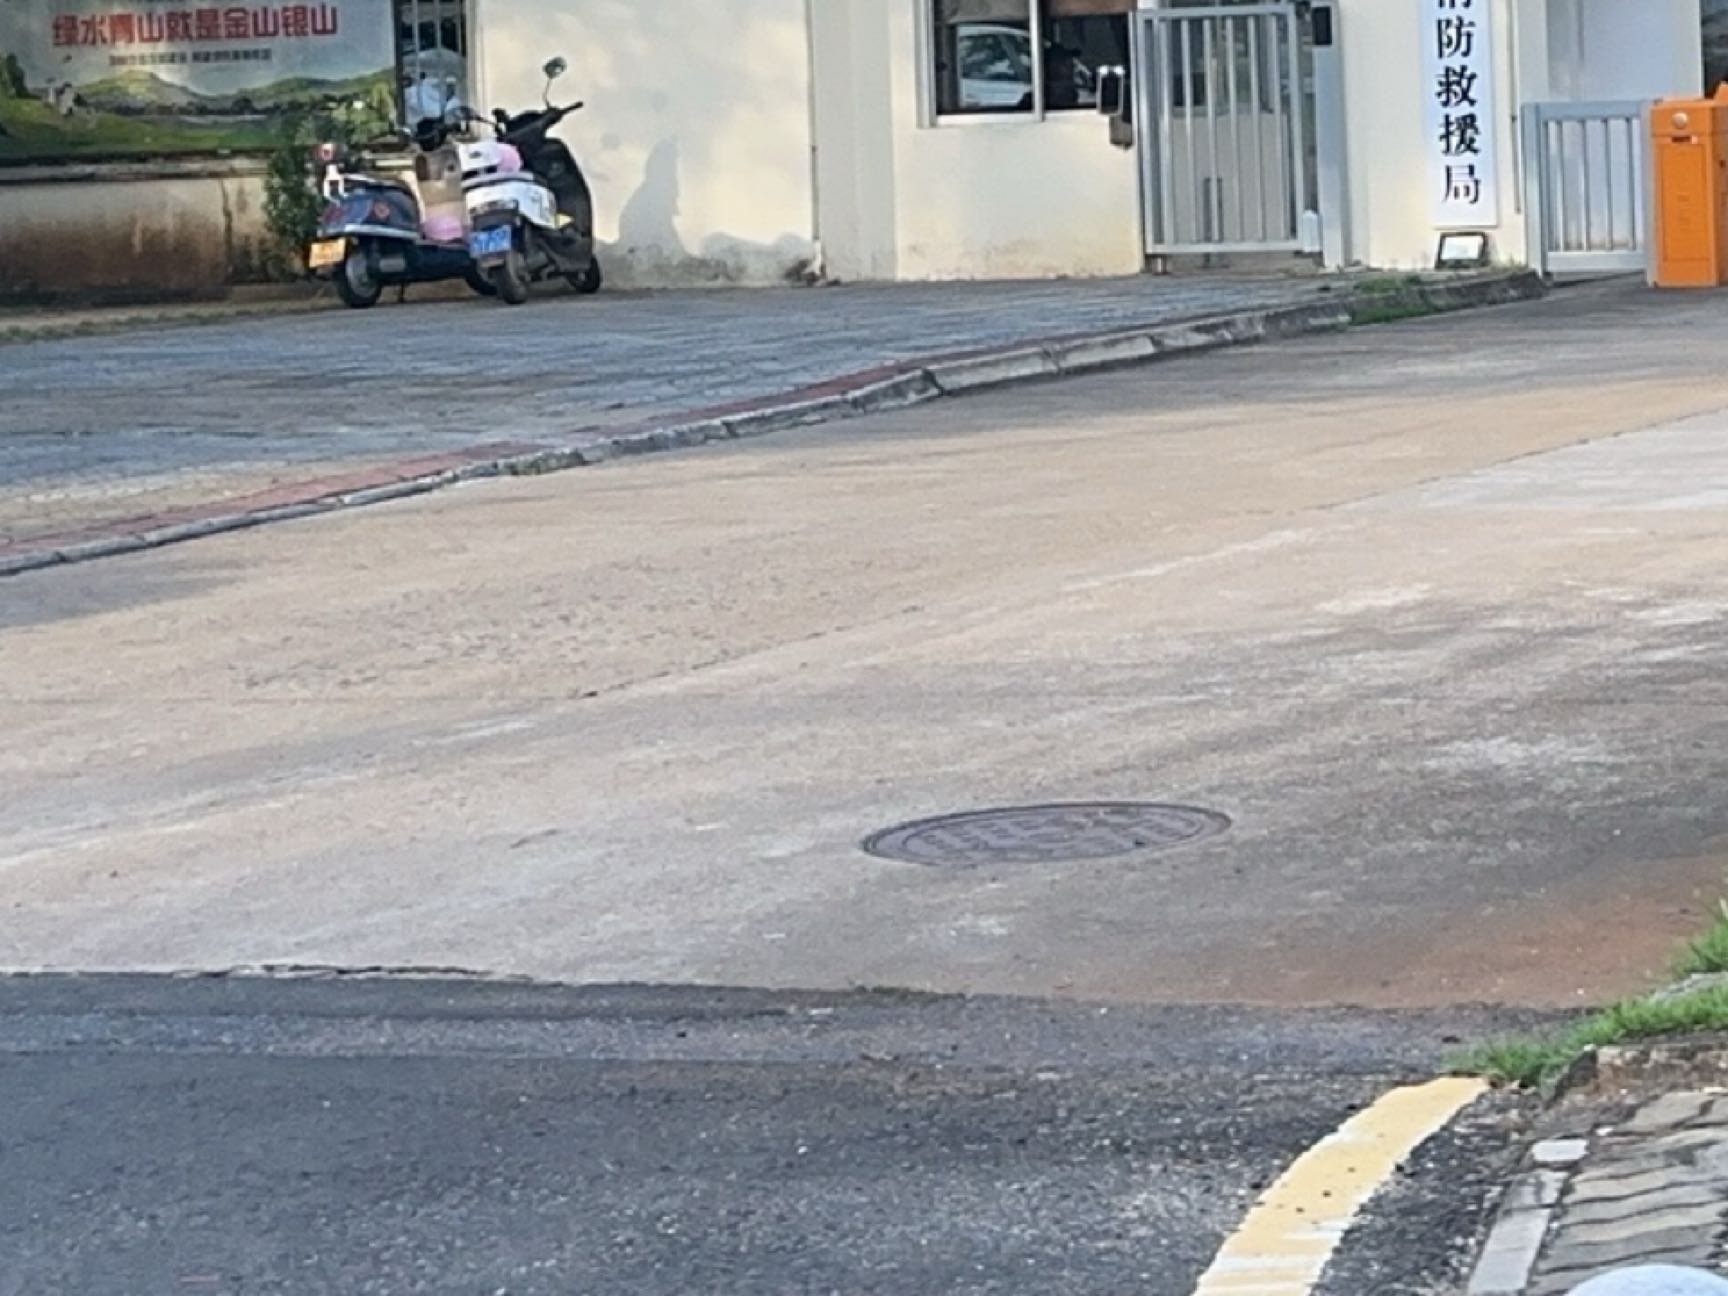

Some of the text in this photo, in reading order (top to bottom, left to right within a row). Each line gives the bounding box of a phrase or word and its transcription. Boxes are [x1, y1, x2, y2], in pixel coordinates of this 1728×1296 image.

[52, 4, 339, 48] 绿水青山就是金山银山
